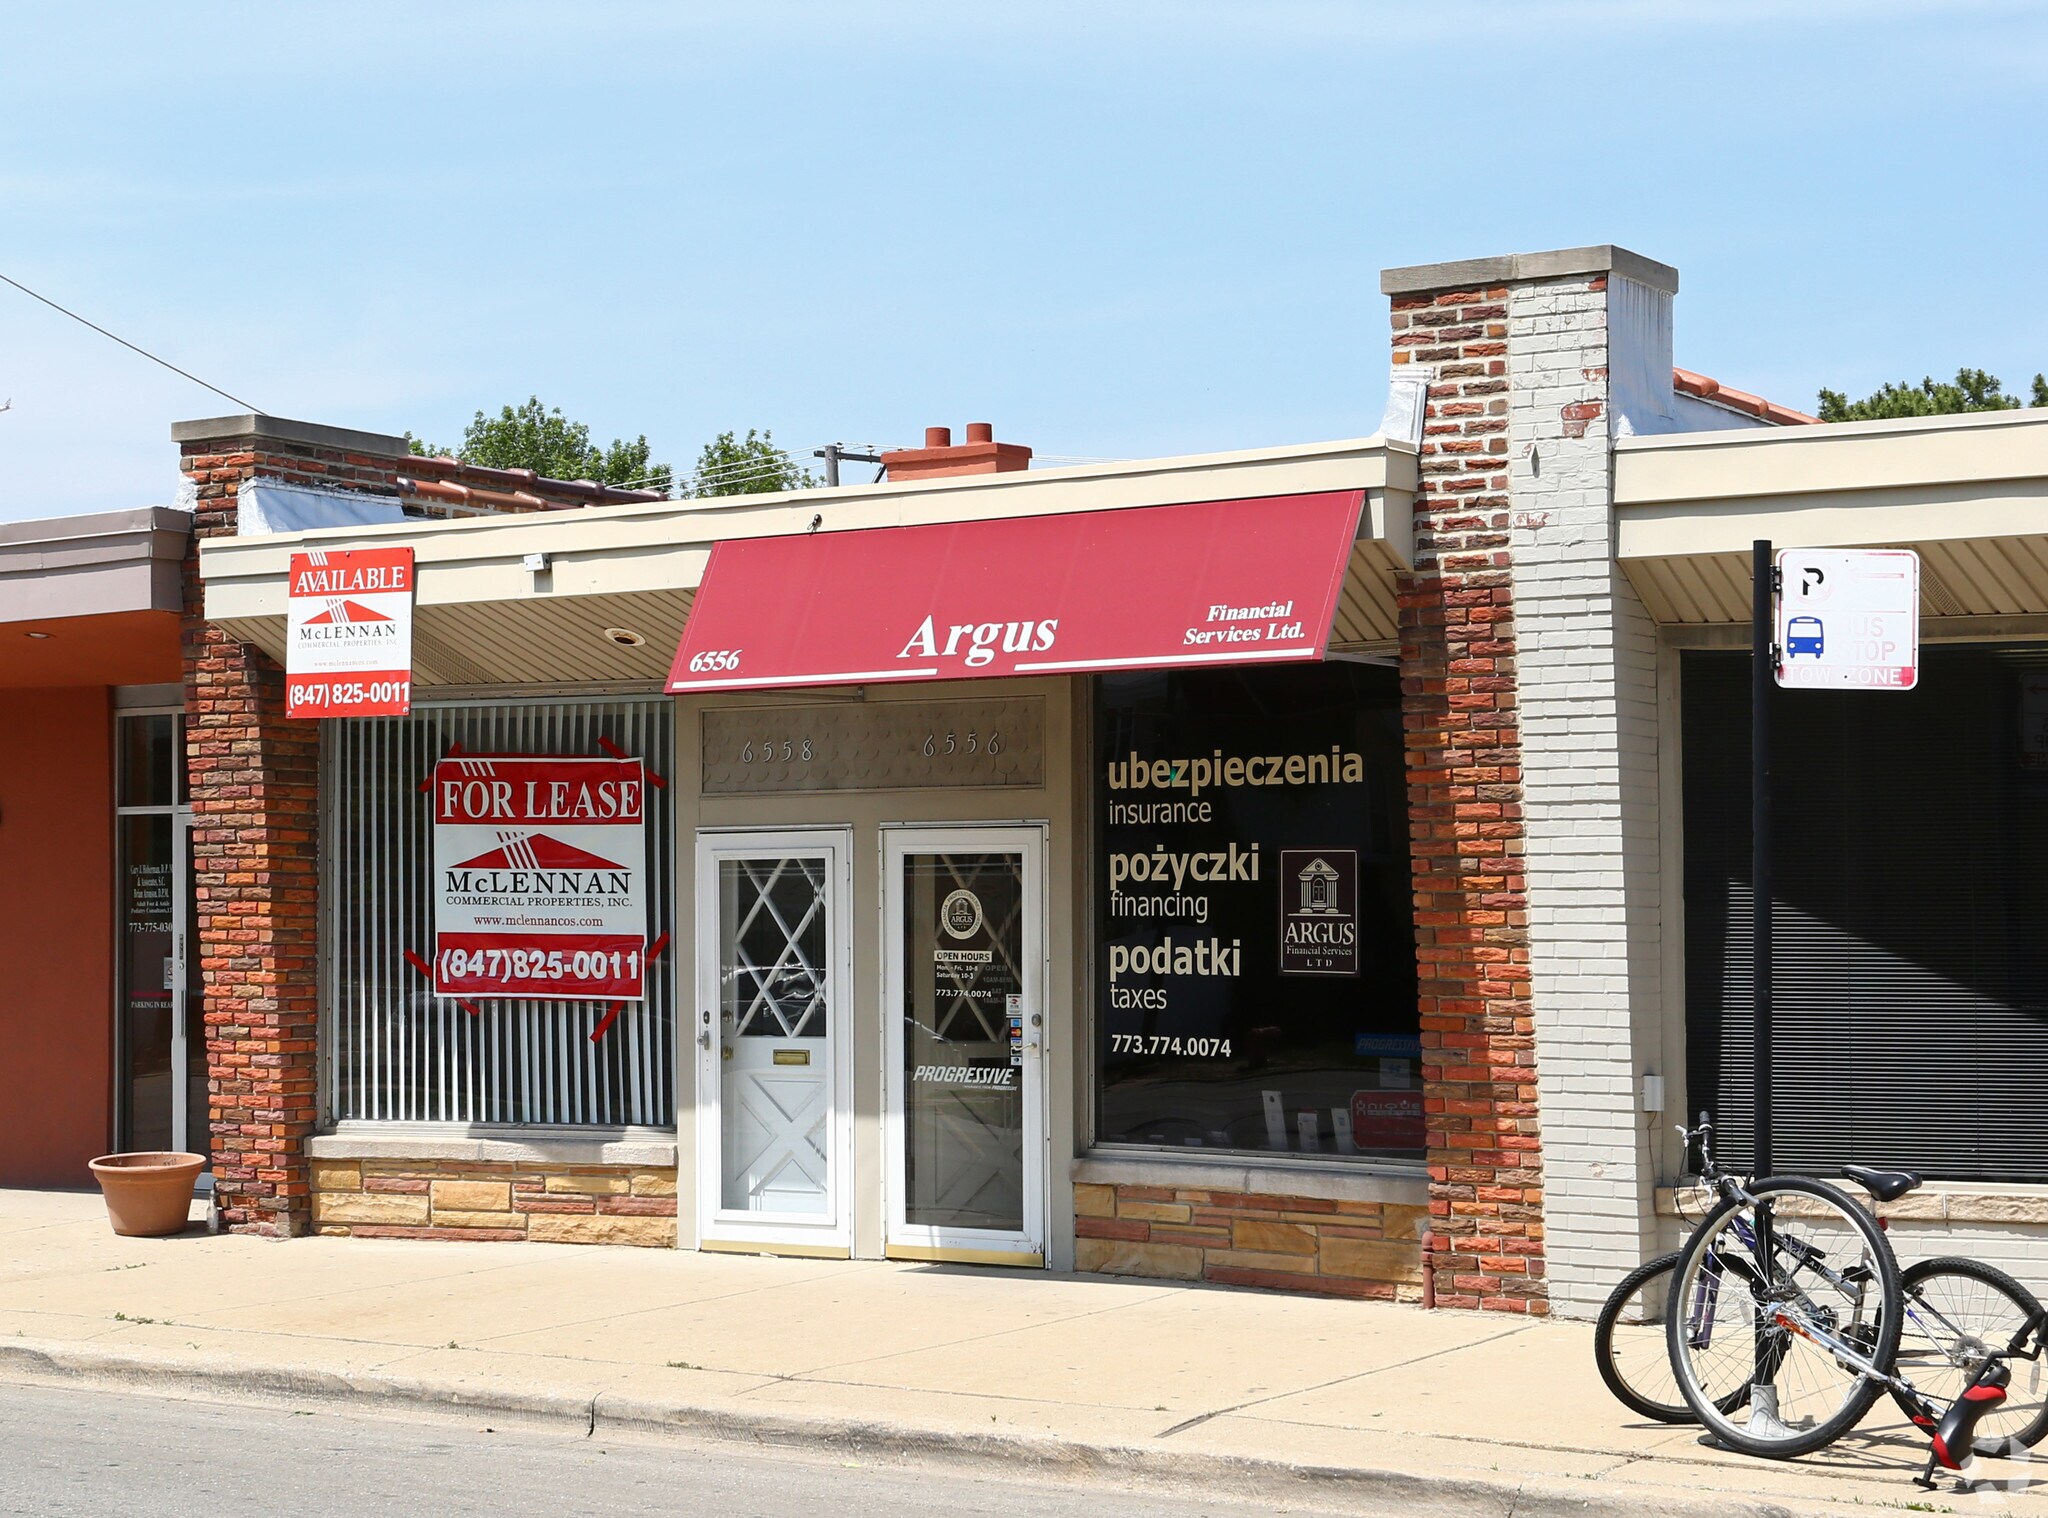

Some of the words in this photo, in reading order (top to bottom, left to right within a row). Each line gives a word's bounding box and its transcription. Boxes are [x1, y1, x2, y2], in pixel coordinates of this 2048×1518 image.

[294, 566, 405, 593] AVAILABLE
[1206, 600, 1293, 622] Financial
[300, 624, 397, 640] McLENNAN
[896, 614, 1059, 667] Argus
[1183, 625, 1261, 645] Services
[1265, 621, 1305, 640] Ltd.
[297, 641, 340, 649] COMMERCIAL
[1837, 640, 1896, 661] TOP
[689, 649, 743, 672] 6556
[1787, 667, 1832, 683] TOW
[1846, 668, 1903, 684] ZONE
[742, 739, 814, 763] 6558
[923, 732, 1000, 757] 6556
[1108, 745, 1364, 797] ubezpieczenia
[441, 780, 516, 818] FOR
[524, 780, 640, 818] LEASE
[1109, 800, 1212, 825] insurance
[1109, 842, 1259, 891] pożyczki
[446, 871, 632, 894] McLENNAN
[446, 896, 525, 906] COMMERCIAL
[527, 897, 604, 908] PROPERTIES,
[607, 897, 633, 907] INC.
[1111, 889, 1209, 924] financing
[129, 922, 173, 932] 773-775-030
[473, 914, 604, 927] www.mclennancos.com
[951, 915, 973, 923] ARGUS
[1284, 922, 1354, 945] ARGUS
[936, 952, 959, 960] OPEN
[961, 953, 990, 961] HOURS
[1109, 937, 1241, 982] podatki
[1286, 944, 1320, 955] Financial
[1322, 945, 1353, 956] Services
[936, 988, 992, 998] 773.774.0074
[1110, 983, 1167, 1010] taxes
[131, 1001, 153, 1009] PARKING
[154, 1001, 160, 1009] IN
[1111, 1034, 1232, 1058] 773.774.0074
[912, 1065, 1015, 1085] PROGRESSIVE
